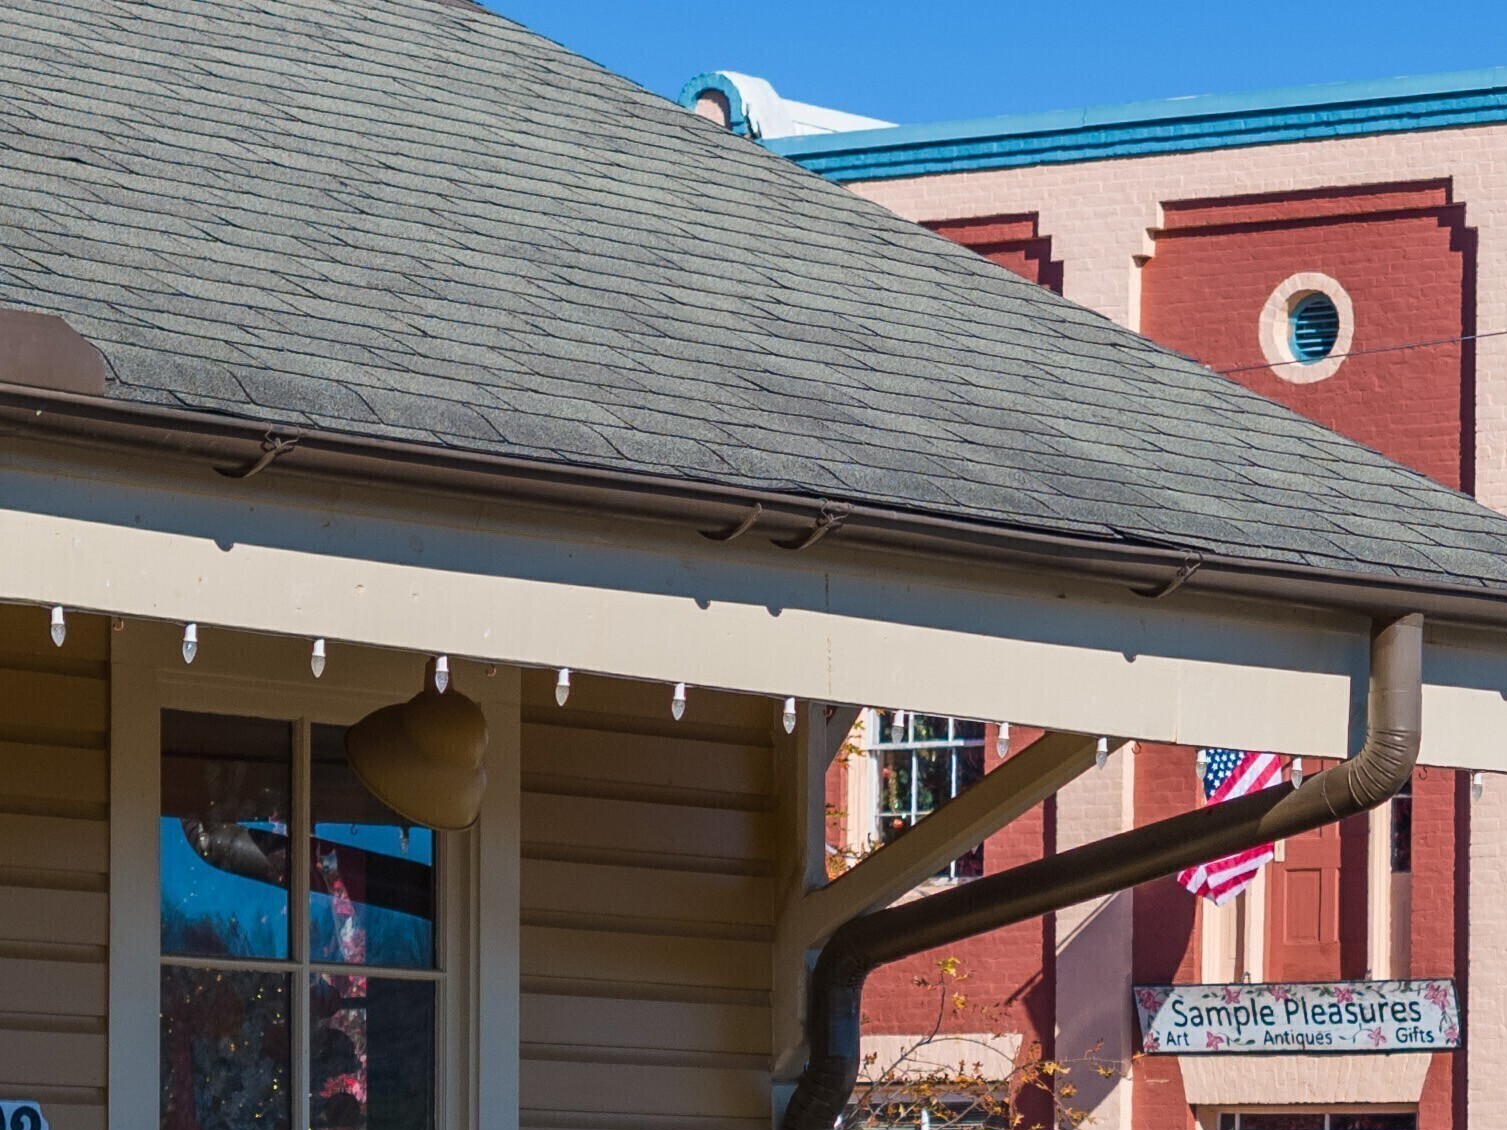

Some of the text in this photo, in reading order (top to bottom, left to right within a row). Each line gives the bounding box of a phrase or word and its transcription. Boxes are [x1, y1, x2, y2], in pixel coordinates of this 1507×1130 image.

[1171, 995, 1422, 1035] Sample Pleasures
[1166, 1026, 1435, 1050] Art Antiques Gifts
